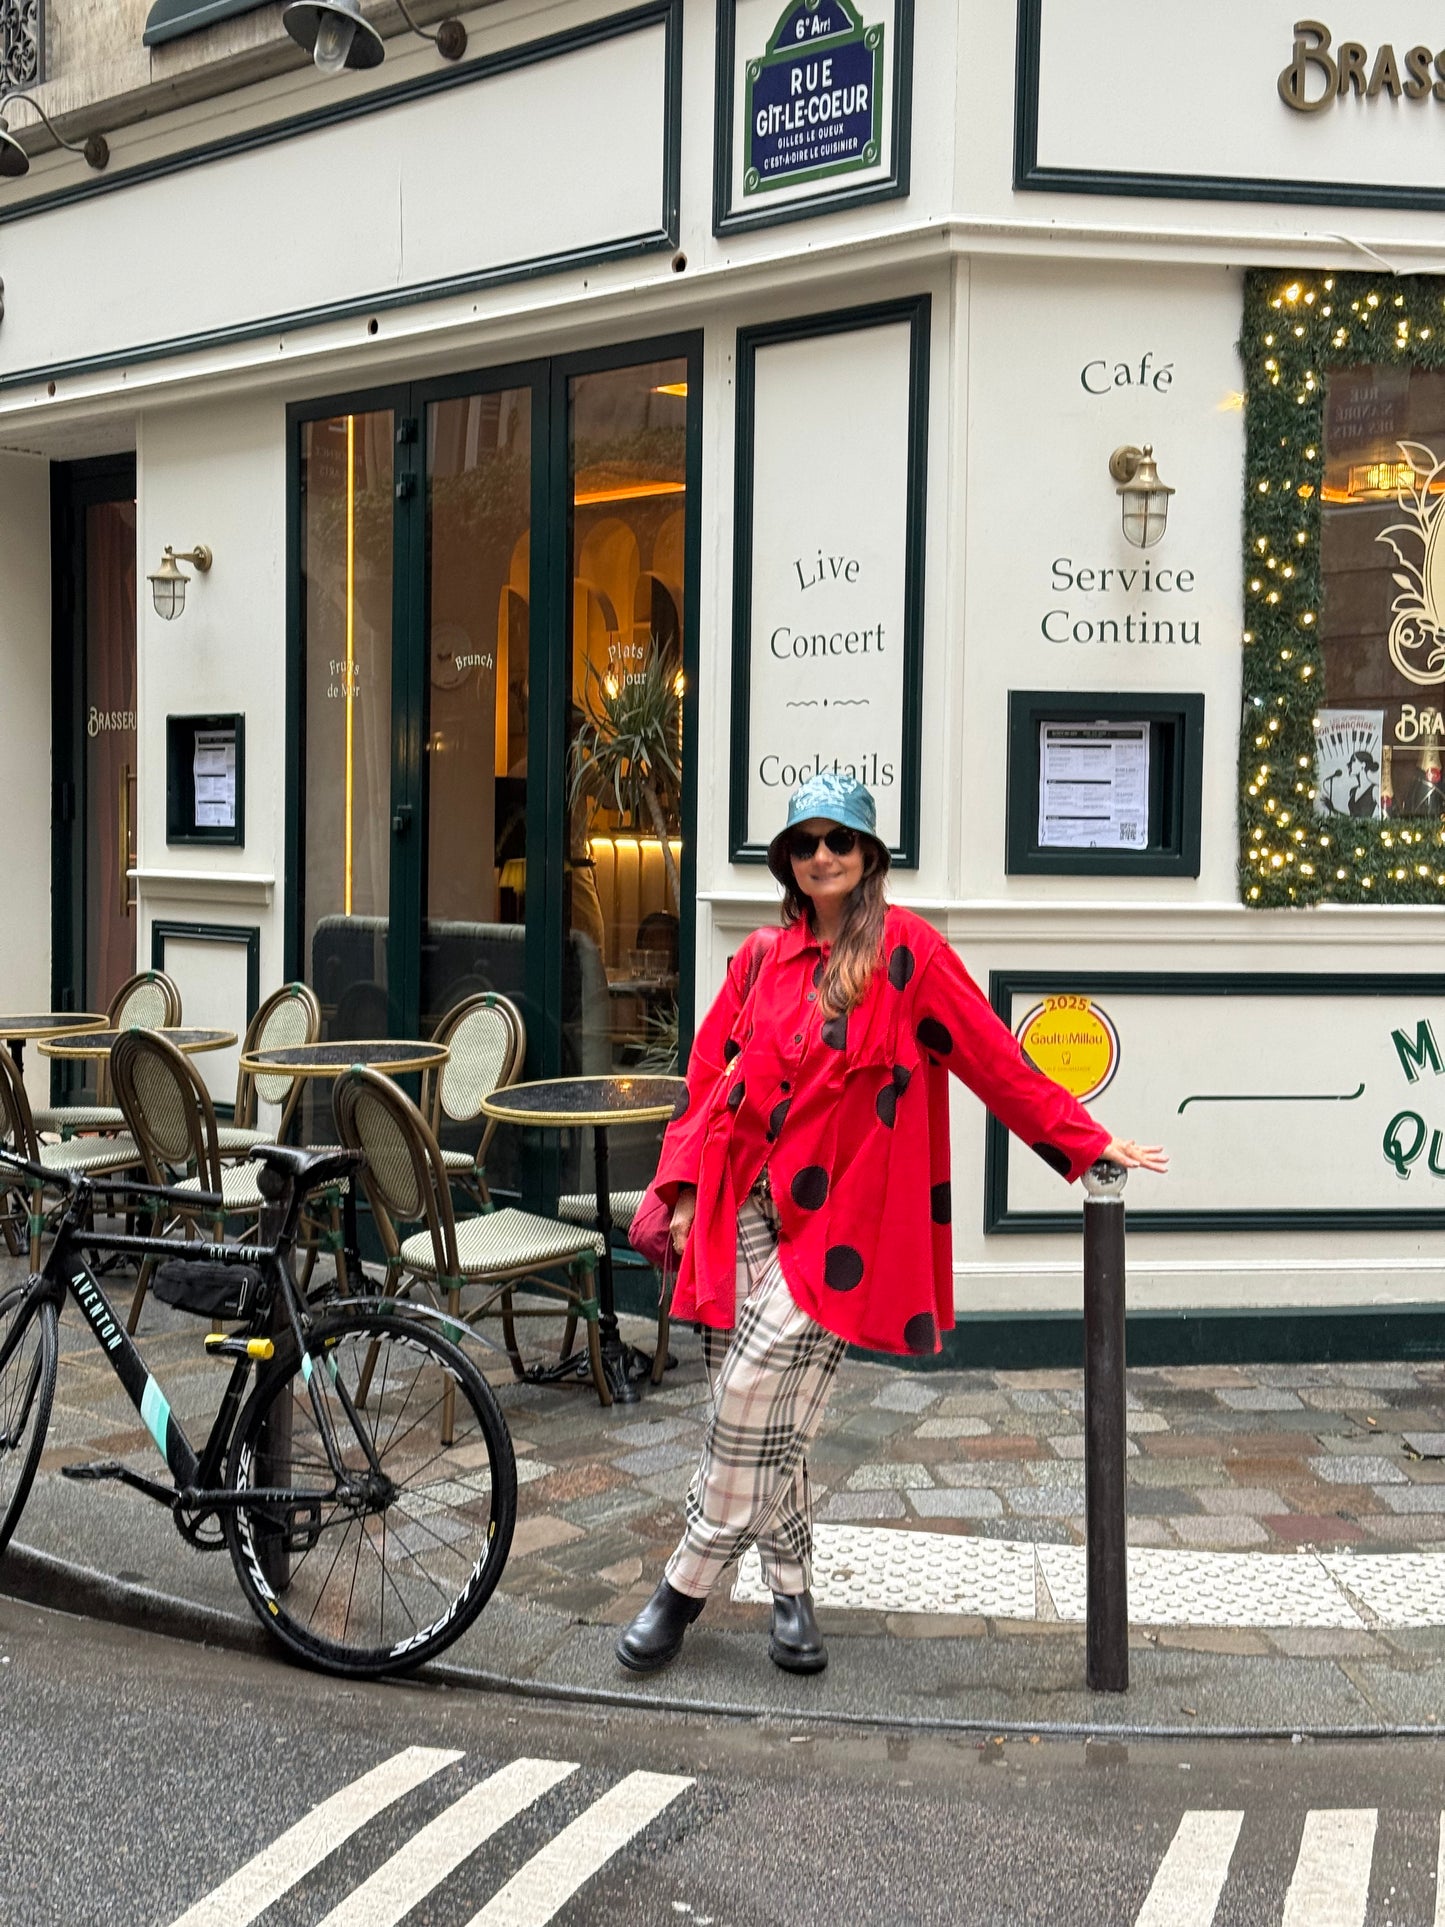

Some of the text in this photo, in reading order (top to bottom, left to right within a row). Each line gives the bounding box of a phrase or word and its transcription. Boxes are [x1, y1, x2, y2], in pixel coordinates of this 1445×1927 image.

[790, 58, 833, 96] RUE
[777, 123, 844, 150] GILLES LE QUEUX
[809, 146, 819, 159] LE
[820, 136, 858, 157] CUISINIER
[1080, 352, 1174, 395] Café
[793, 549, 860, 592] Live
[1051, 557, 1195, 593] Service
[770, 622, 886, 660] Concert
[1041, 609, 1202, 646] Continu
[329, 659, 360, 676] Frus
[455, 652, 493, 672] Brunch
[608, 641, 644, 663] Plats
[327, 682, 360, 698] de Mr
[622, 669, 647, 691] jour
[1047, 995, 1088, 1012] 2025
[1390, 1018, 1445, 1085] M
[71, 1271, 123, 1351] AVENTON
